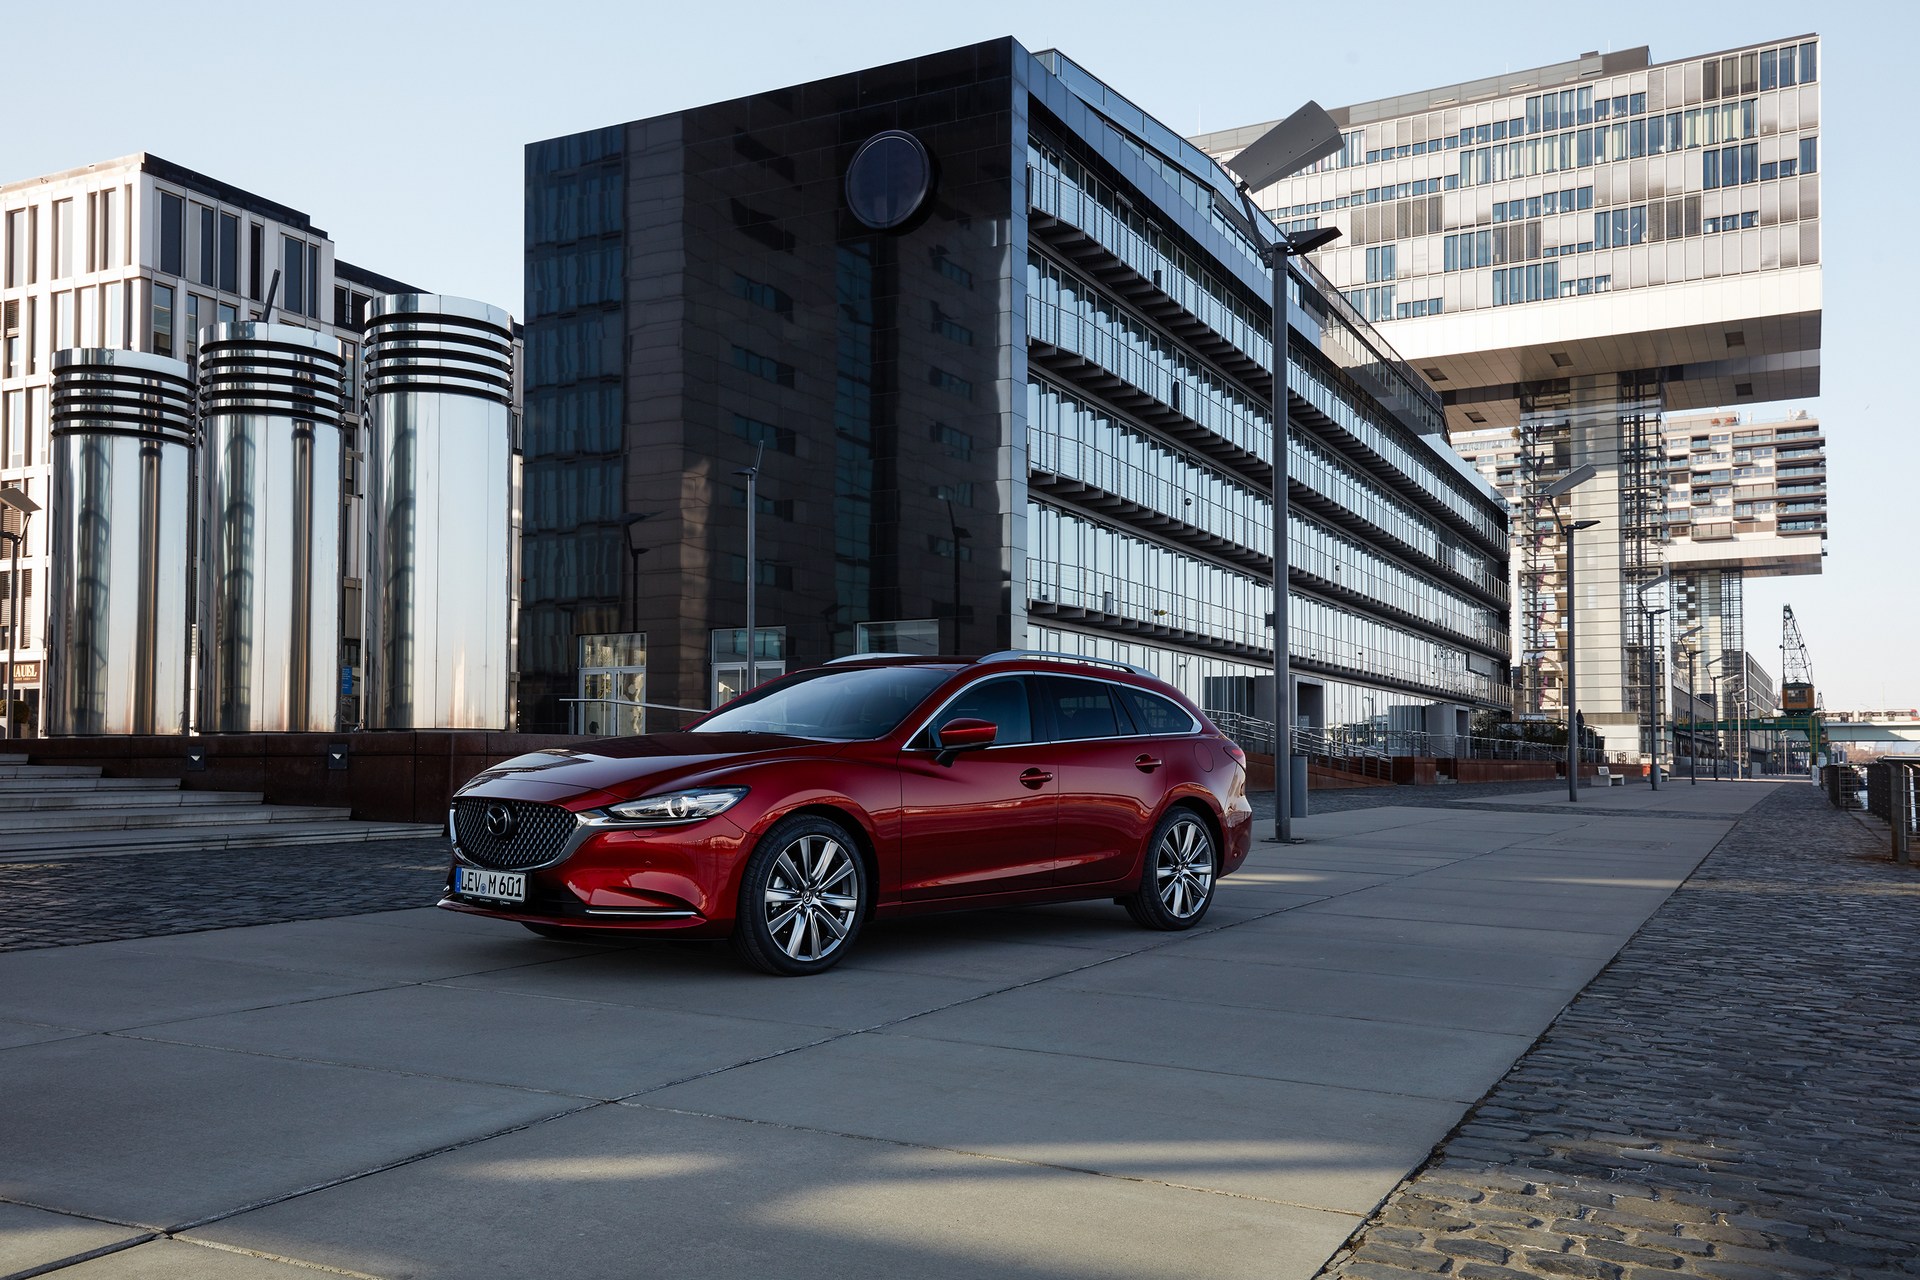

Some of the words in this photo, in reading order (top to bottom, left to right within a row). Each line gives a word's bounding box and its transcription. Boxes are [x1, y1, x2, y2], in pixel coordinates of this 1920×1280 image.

[461, 871, 482, 892] LEV
[488, 874, 497, 894] M
[499, 876, 522, 897] 601
